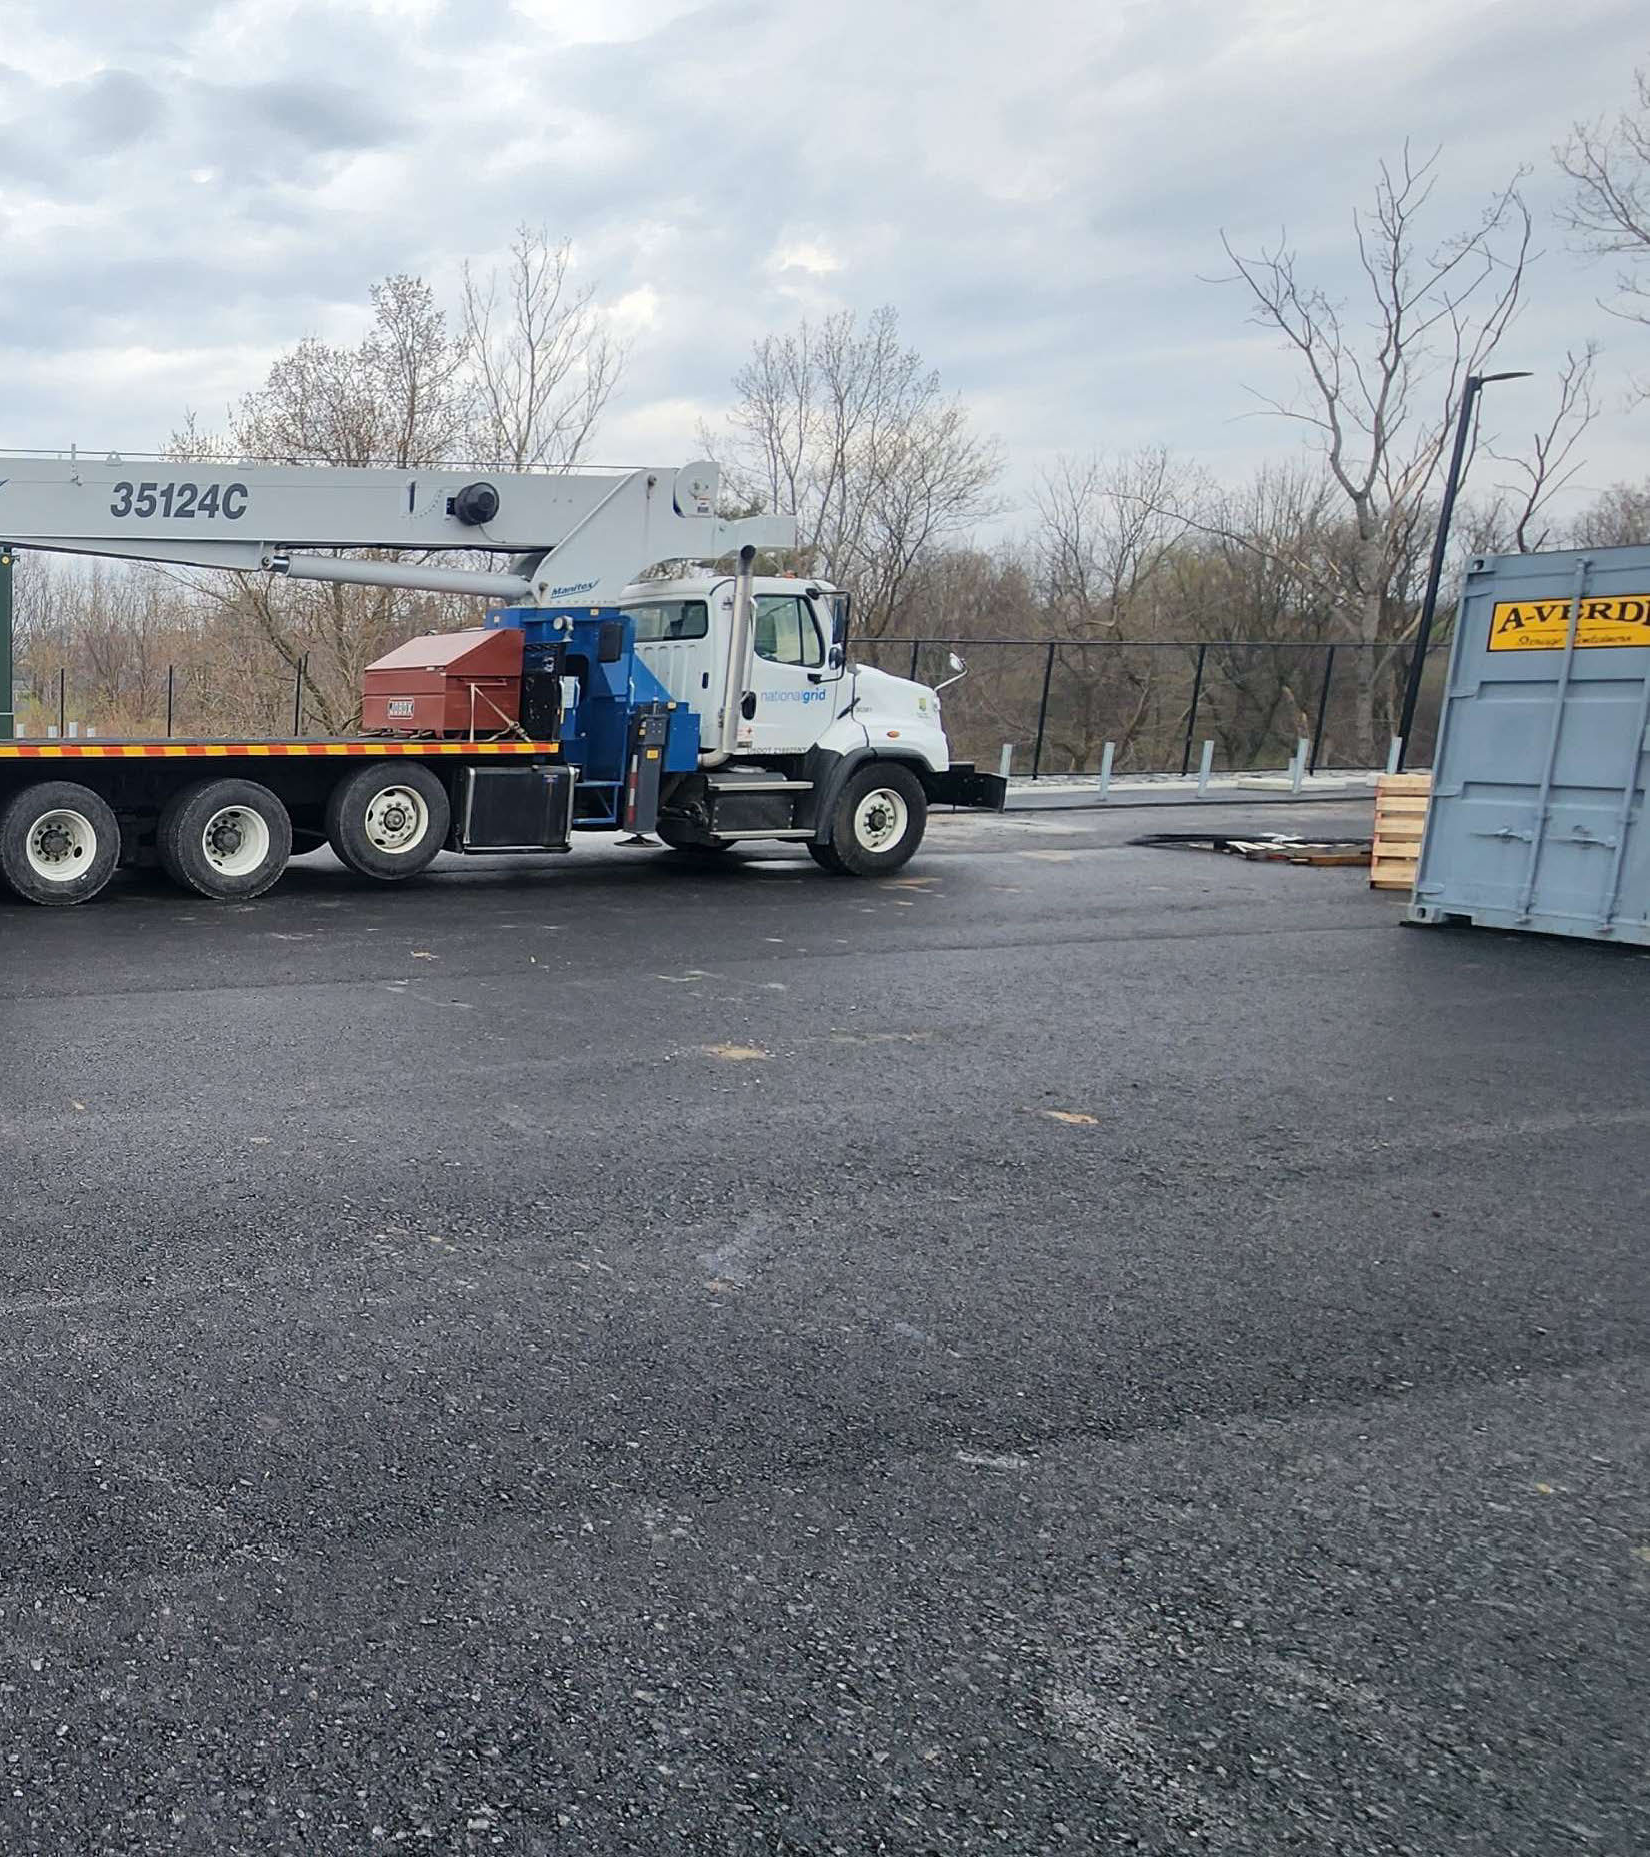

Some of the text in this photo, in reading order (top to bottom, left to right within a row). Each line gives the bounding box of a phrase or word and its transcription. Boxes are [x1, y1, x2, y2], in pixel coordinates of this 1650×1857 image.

[110, 481, 248, 520] 35124C
[551, 582, 593, 597] Manitex
[761, 688, 826, 704] nationalgrid
